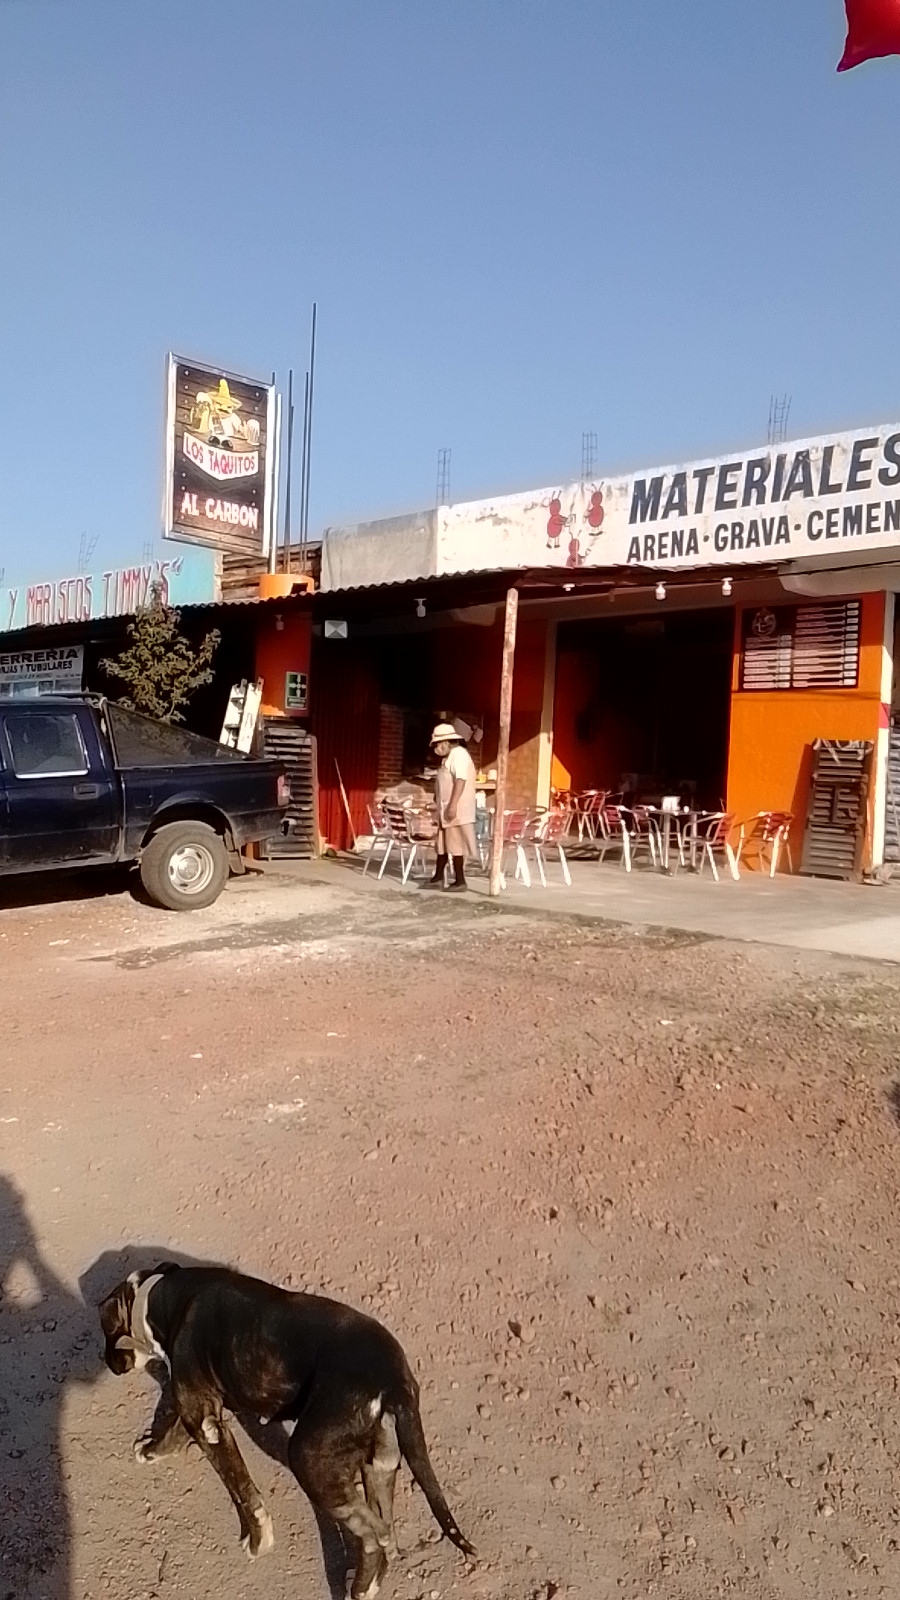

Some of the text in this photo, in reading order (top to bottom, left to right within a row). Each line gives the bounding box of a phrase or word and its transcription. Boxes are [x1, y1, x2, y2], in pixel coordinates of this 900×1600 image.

[185, 435, 256, 475] LOS TAQUITOS
[628, 432, 900, 525] MATERIALES
[181, 492, 259, 531] AL CARBON
[626, 527, 700, 564] ARENA
[713, 514, 791, 552] GRAVA
[8, 589, 18, 631] Y
[26, 660, 73, 673] TUBULARES
